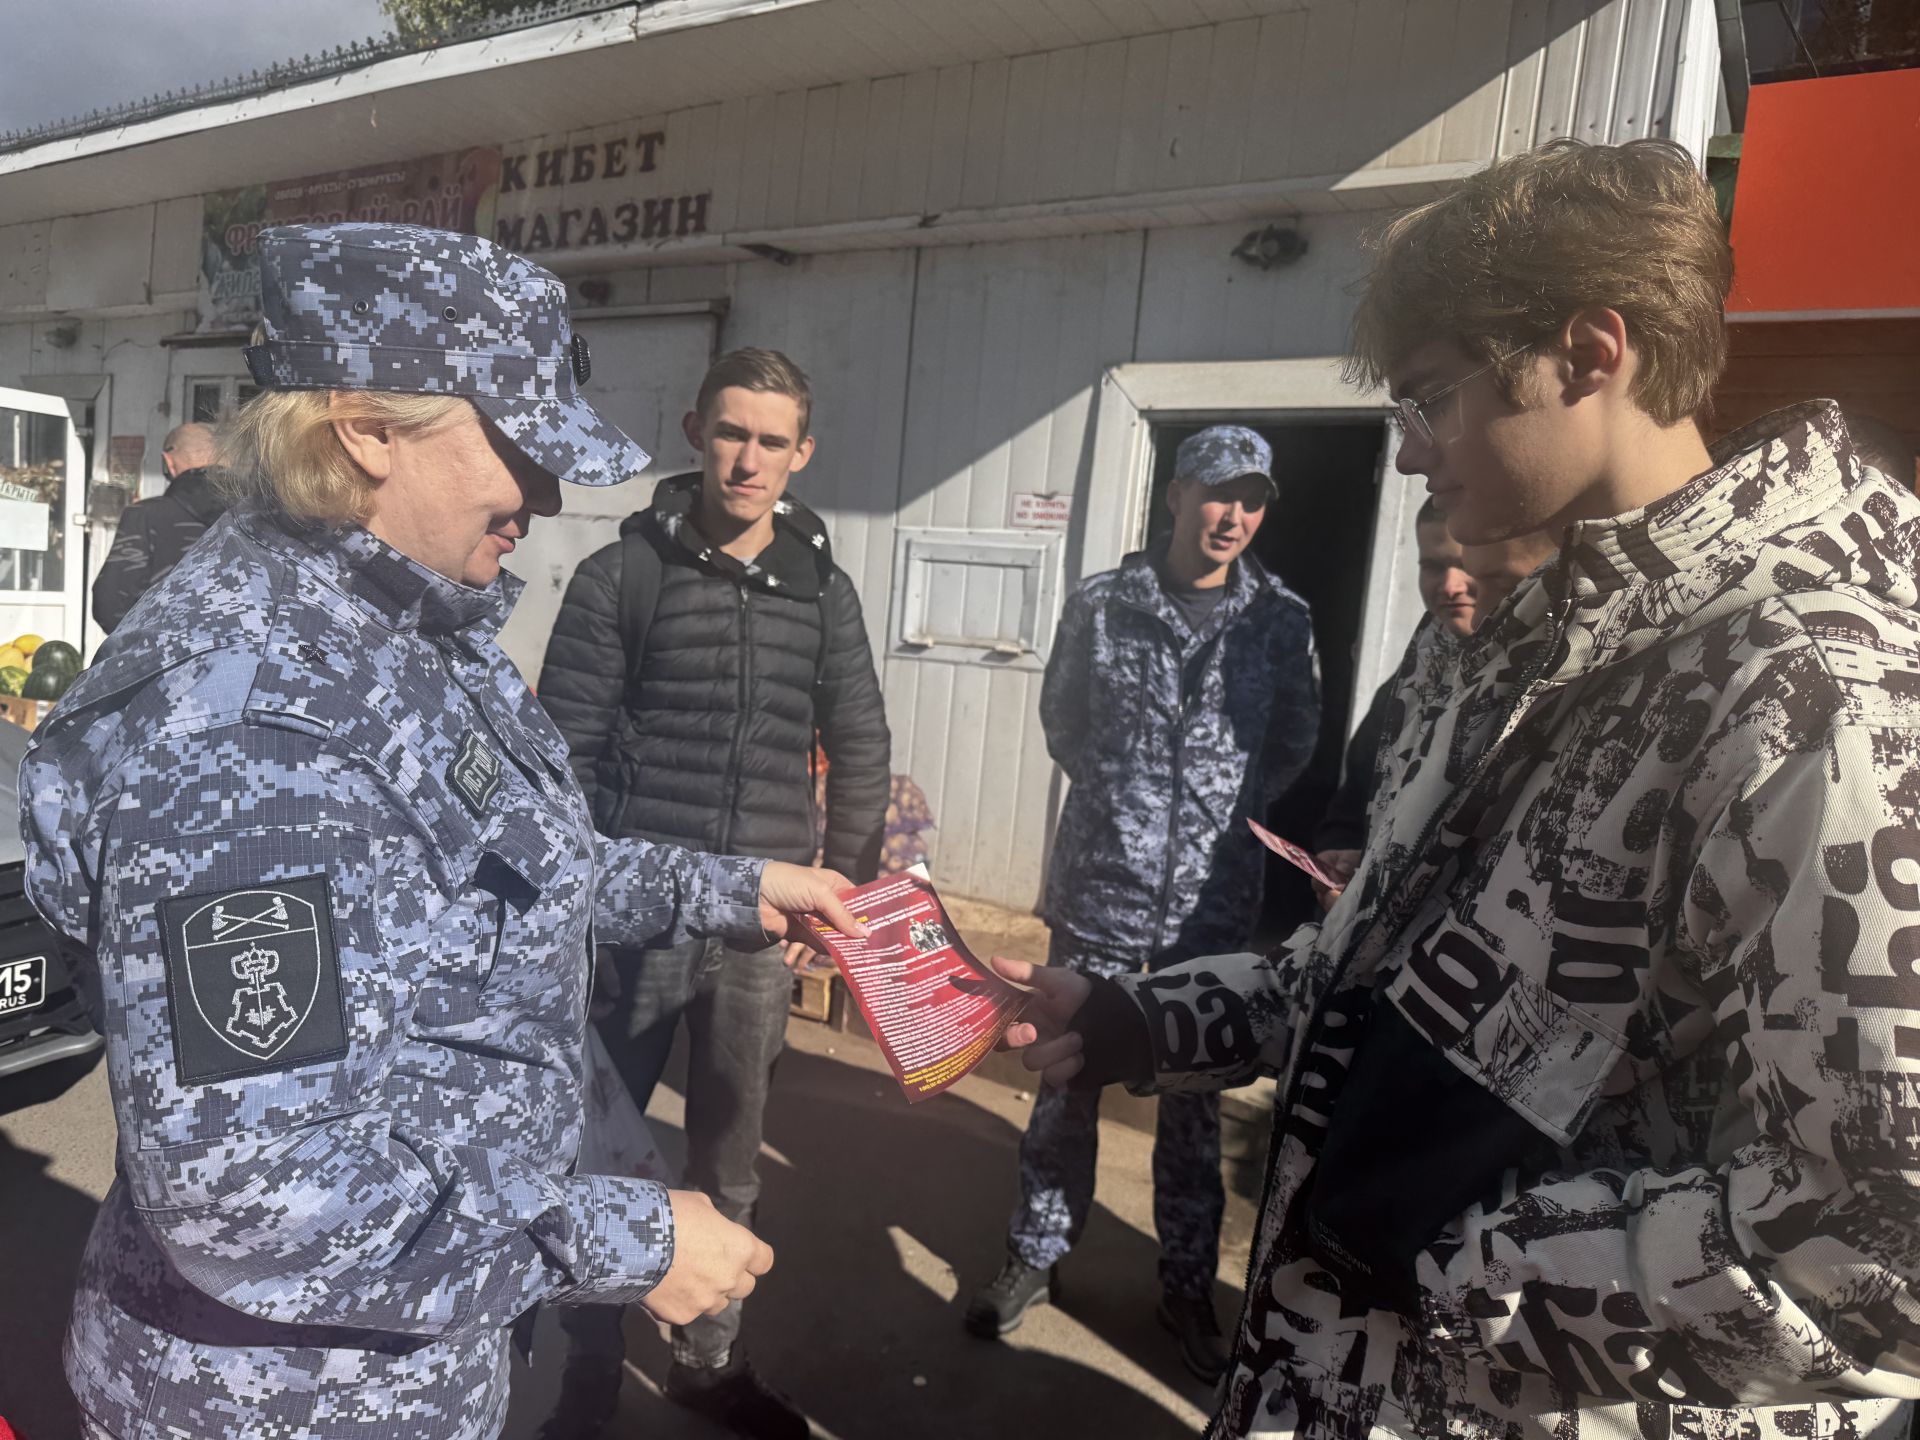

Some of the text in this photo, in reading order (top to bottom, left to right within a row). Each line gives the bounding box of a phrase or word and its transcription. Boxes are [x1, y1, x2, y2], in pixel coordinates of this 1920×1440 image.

[500, 131, 665, 193] КИБЕТ
[497, 190, 713, 254] МАГАЗИН
[0, 993, 27, 1010] RUS
